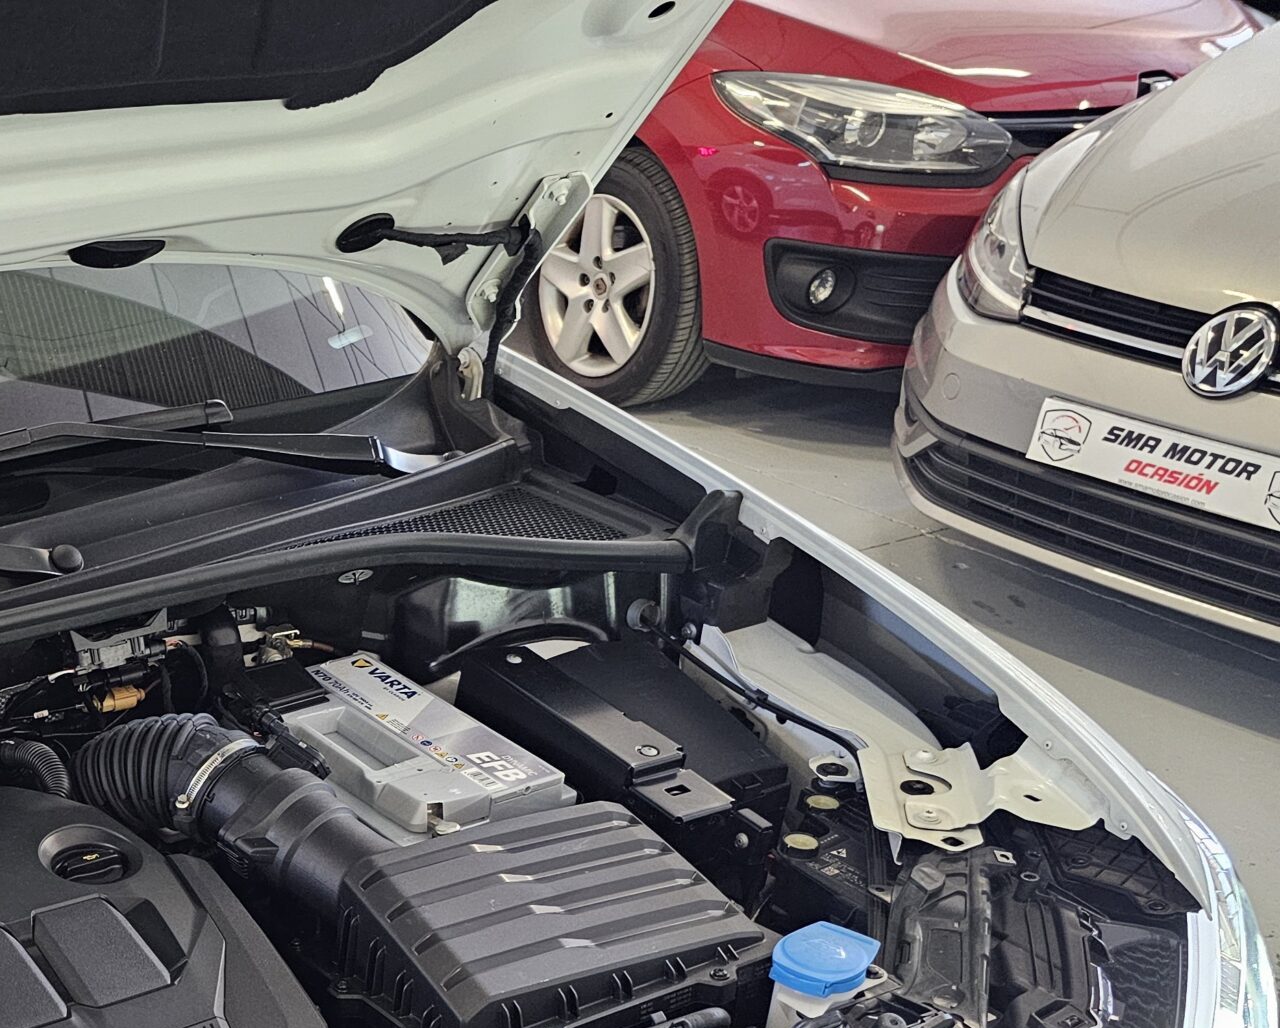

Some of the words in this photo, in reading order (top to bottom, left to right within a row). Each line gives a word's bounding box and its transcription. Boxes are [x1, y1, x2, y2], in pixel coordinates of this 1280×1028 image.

[1102, 426, 1162, 454] SMA
[1162, 442, 1261, 480] MOTOR
[1124, 459, 1219, 495] OCASIÓN
[311, 669, 332, 682] N70
[368, 668, 418, 699] VARTA
[466, 751, 527, 782] EFB
